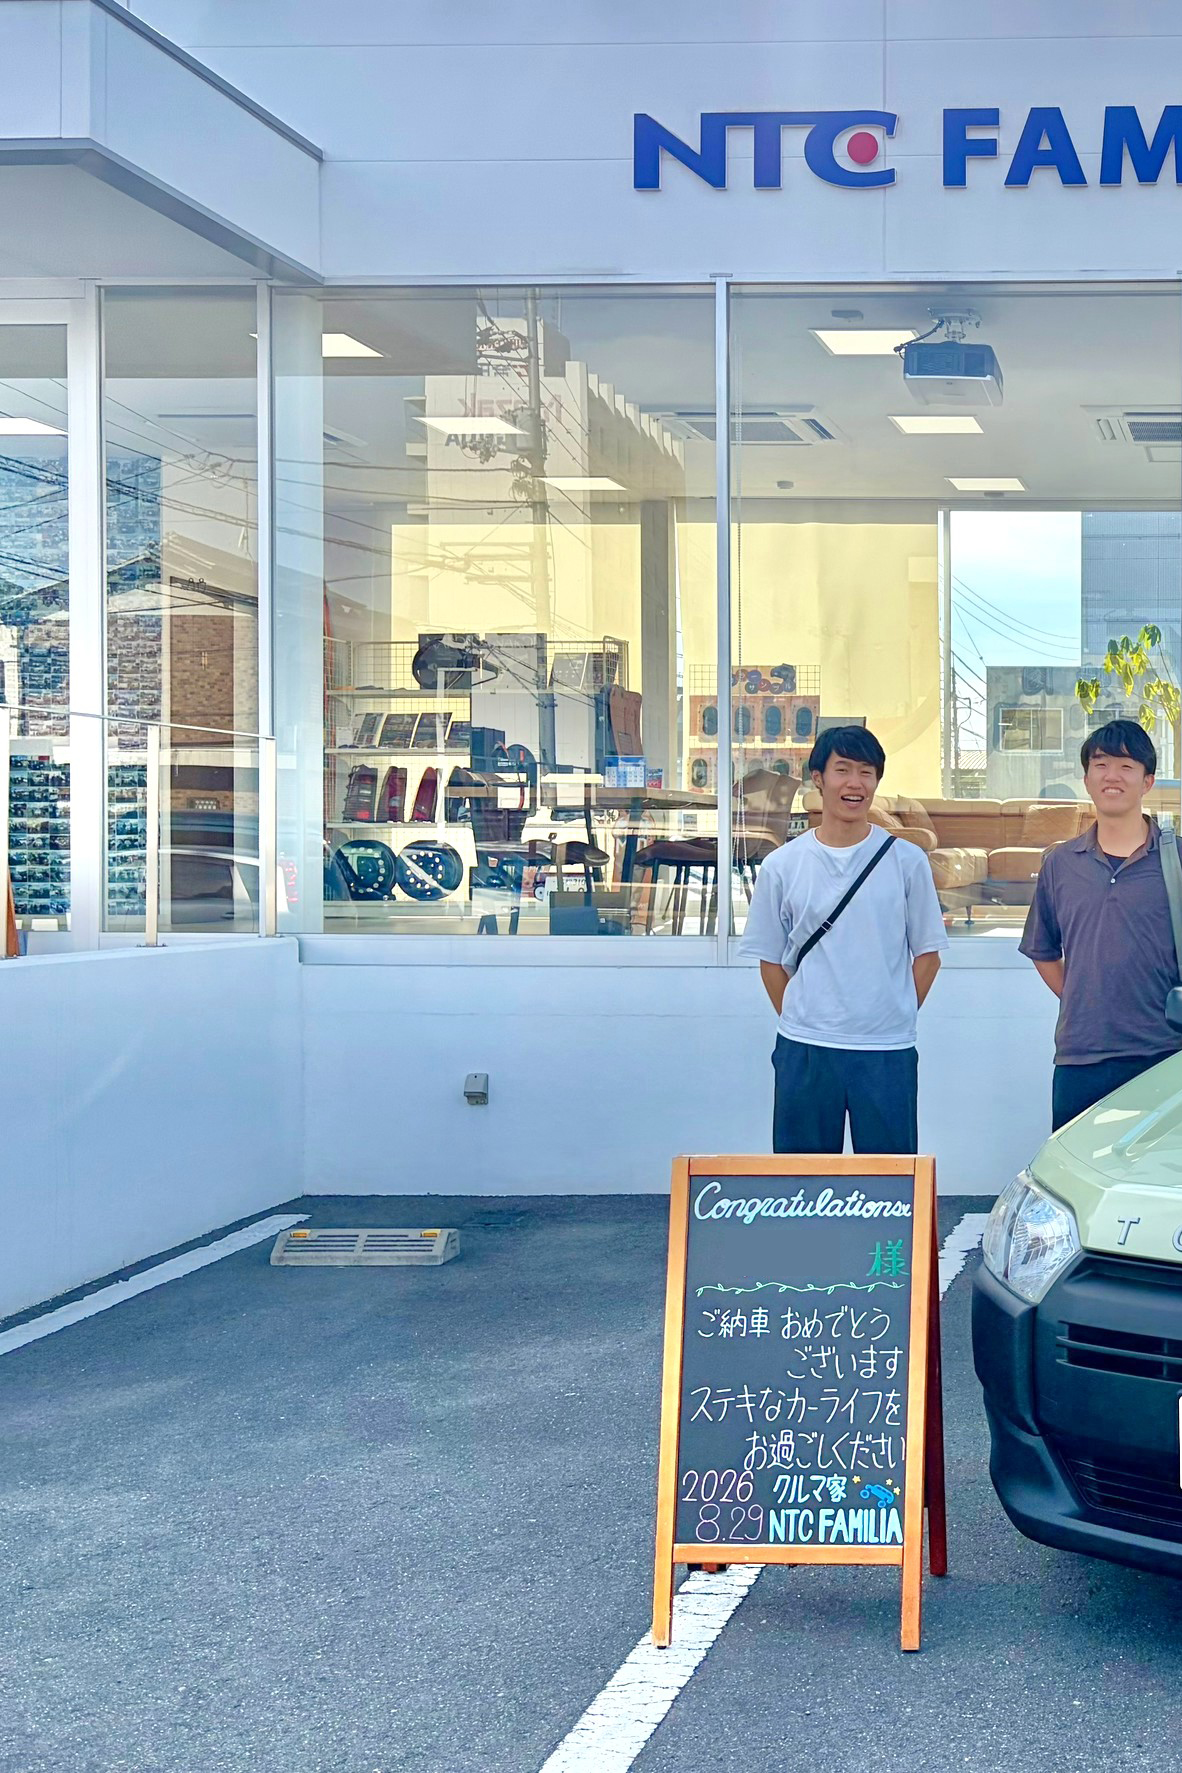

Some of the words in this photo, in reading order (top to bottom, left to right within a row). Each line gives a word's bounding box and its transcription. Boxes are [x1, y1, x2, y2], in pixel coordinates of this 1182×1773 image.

[633, 110, 898, 190] NTC
[694, 1181, 912, 1224] Congratulations
[866, 1239, 909, 1277] 様
[698, 1306, 770, 1338] ご納車
[780, 1305, 891, 1340] おめでとう
[786, 1344, 904, 1379] ございます
[690, 1384, 901, 1426] ステキなカーライフを
[743, 1429, 906, 1470] お過ごしください
[681, 1469, 755, 1503] 2026
[773, 1473, 848, 1504] クルマ家
[695, 1503, 764, 1542] 8.29
[768, 1508, 814, 1543] NTC
[818, 1507, 904, 1543] FAMILIA
